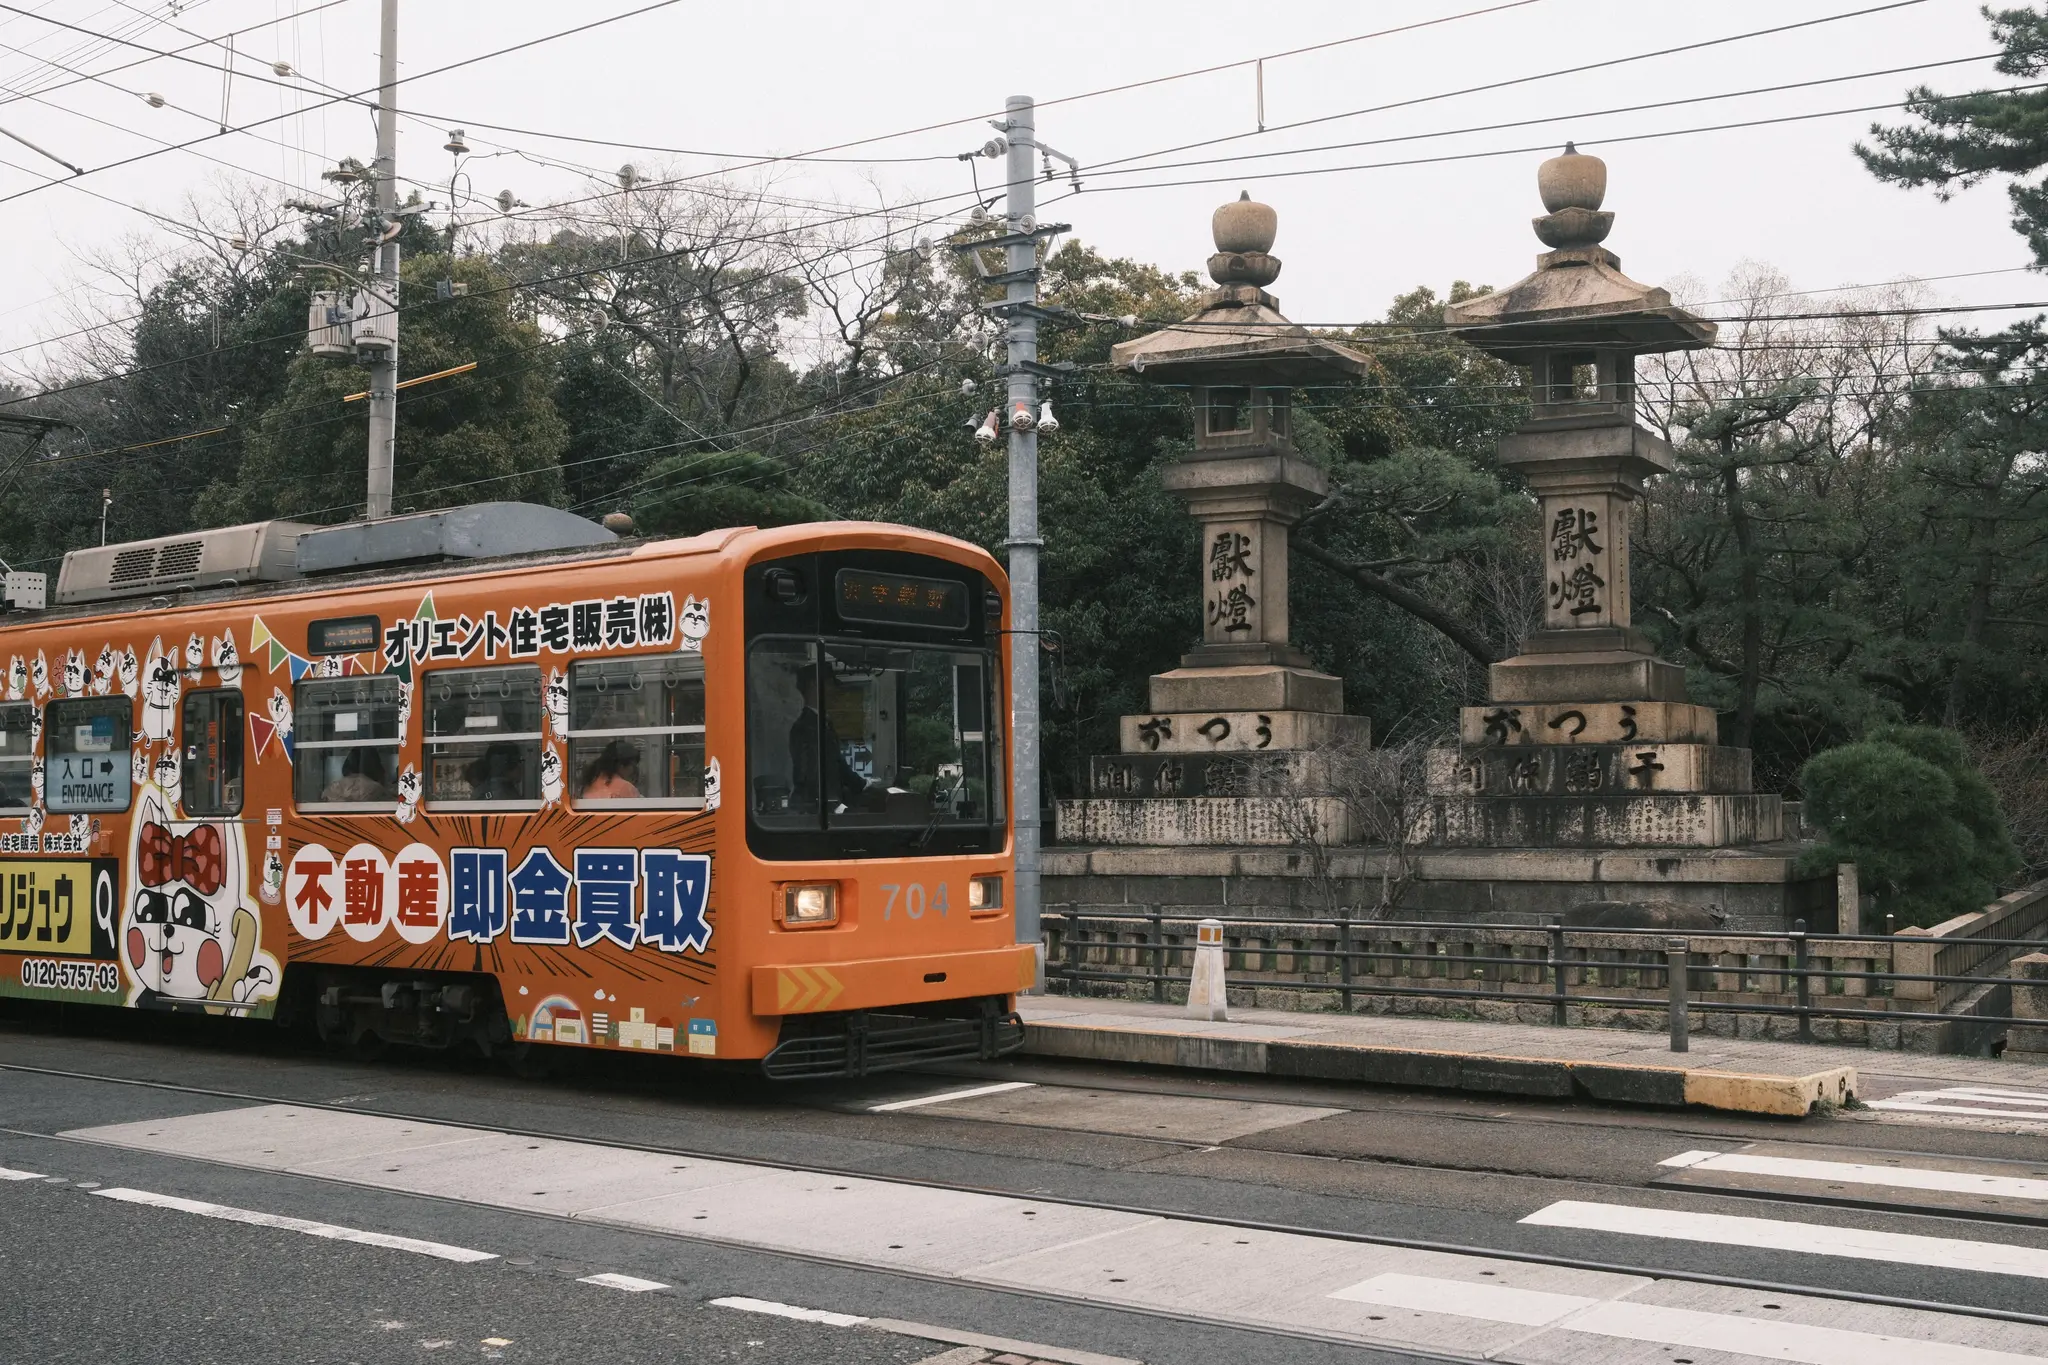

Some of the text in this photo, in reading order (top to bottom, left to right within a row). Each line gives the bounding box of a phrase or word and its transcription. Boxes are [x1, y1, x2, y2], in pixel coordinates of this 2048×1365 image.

[62, 758, 93, 779] 入口
[62, 783, 114, 803] ENTRANCE
[44, 834, 83, 851] 株式会社
[880, 881, 950, 921] 704
[22, 960, 119, 990] 0120-5757-03
